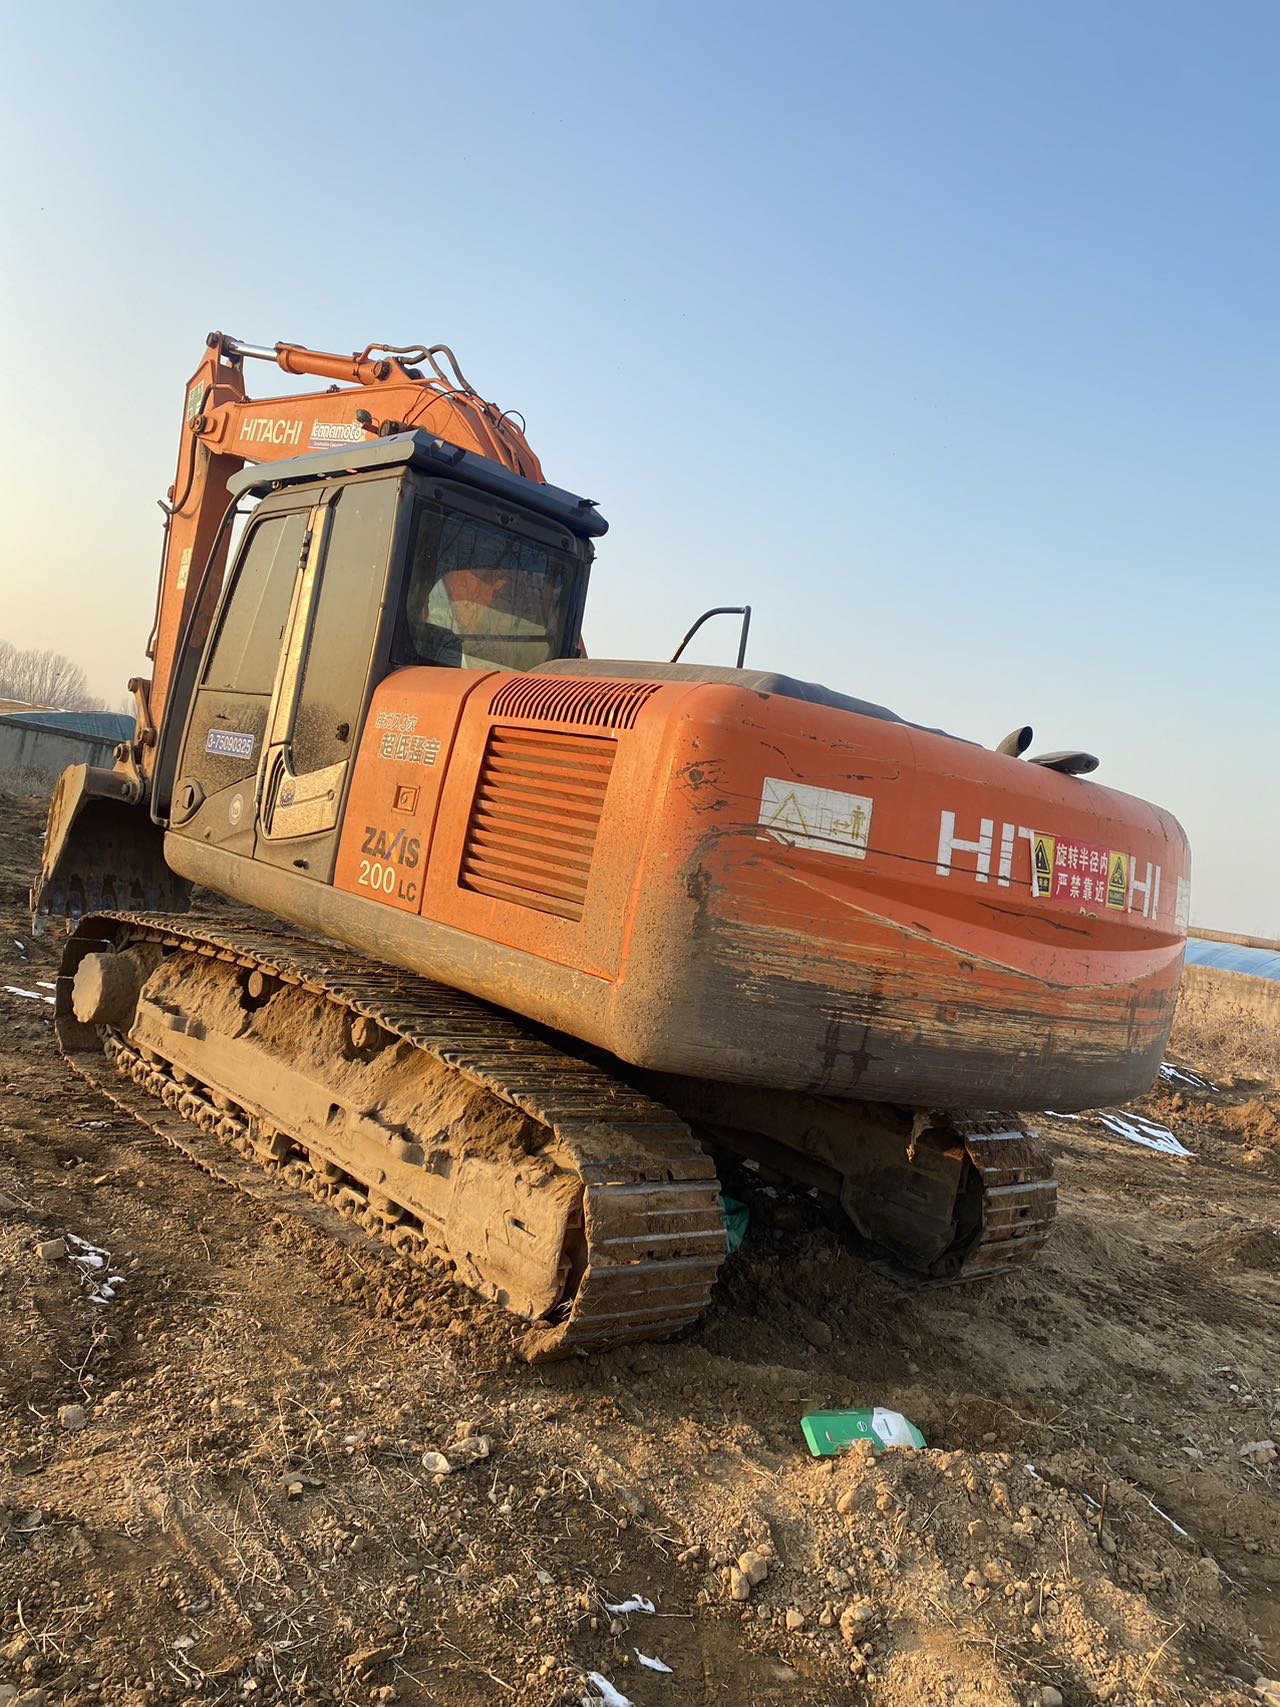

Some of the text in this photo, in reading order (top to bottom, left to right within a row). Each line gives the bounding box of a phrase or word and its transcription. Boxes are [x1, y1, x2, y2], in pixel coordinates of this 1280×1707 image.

[239, 418, 304, 445] HITACHI
[311, 419, 363, 442] kanamoto
[361, 826, 421, 869] ZAXIS
[1055, 843, 1109, 876] 旋转半径内
[358, 859, 417, 902] 200 LC
[1055, 872, 1105, 903] 严禁靠近
